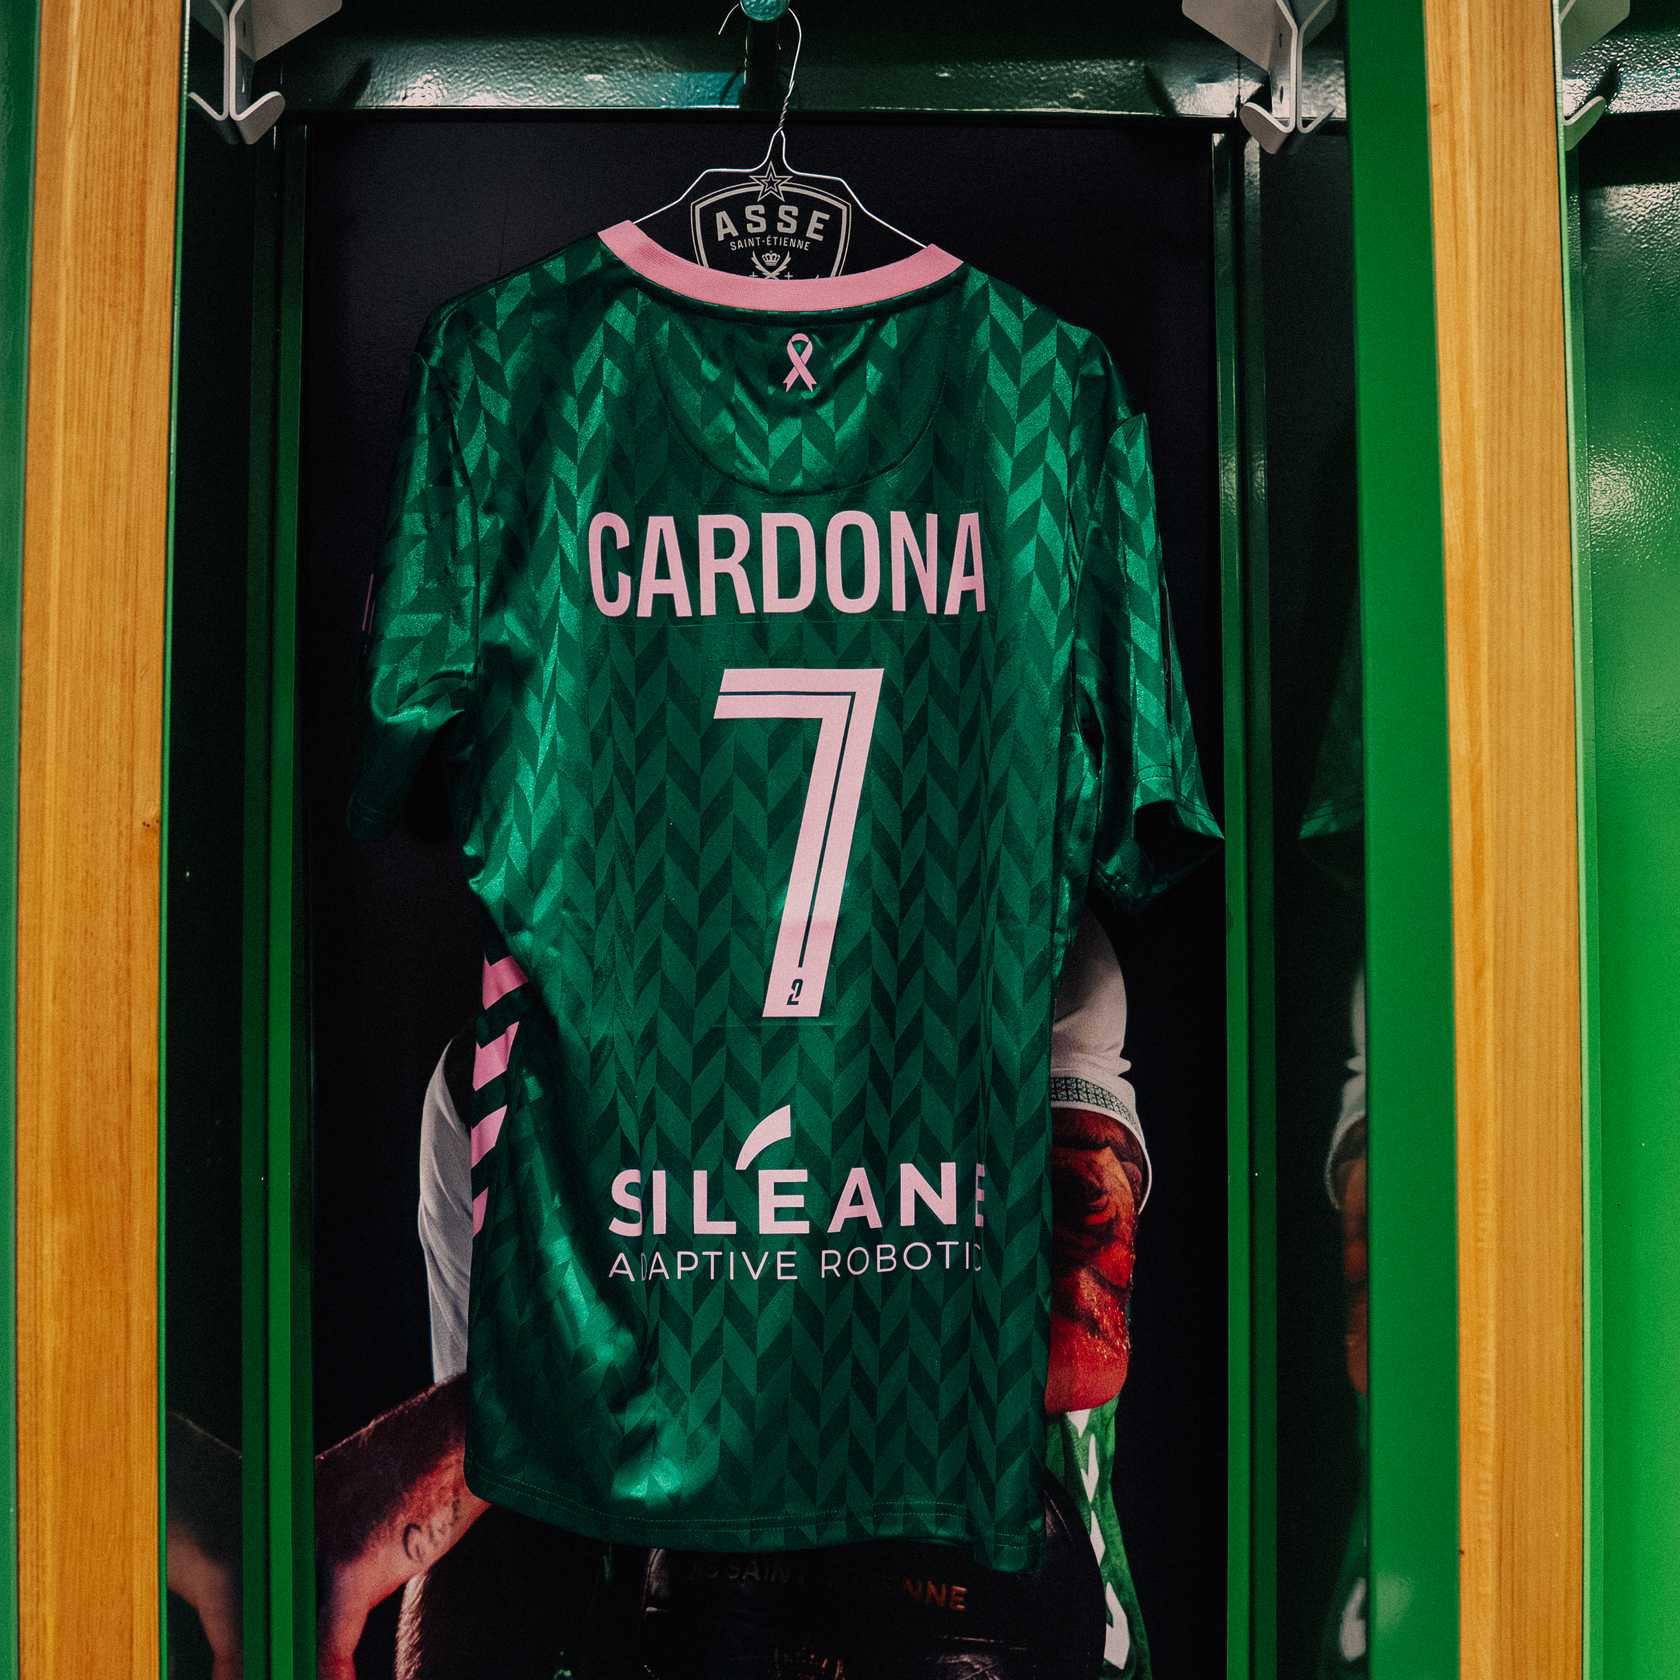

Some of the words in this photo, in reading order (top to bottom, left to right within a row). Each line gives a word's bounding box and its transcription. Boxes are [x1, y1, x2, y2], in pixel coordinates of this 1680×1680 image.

[715, 205, 831, 243] ASSE
[730, 235, 811, 252] SAINT-ÉTIENNE
[588, 510, 986, 618] CARDONA
[713, 668, 884, 1018] 7
